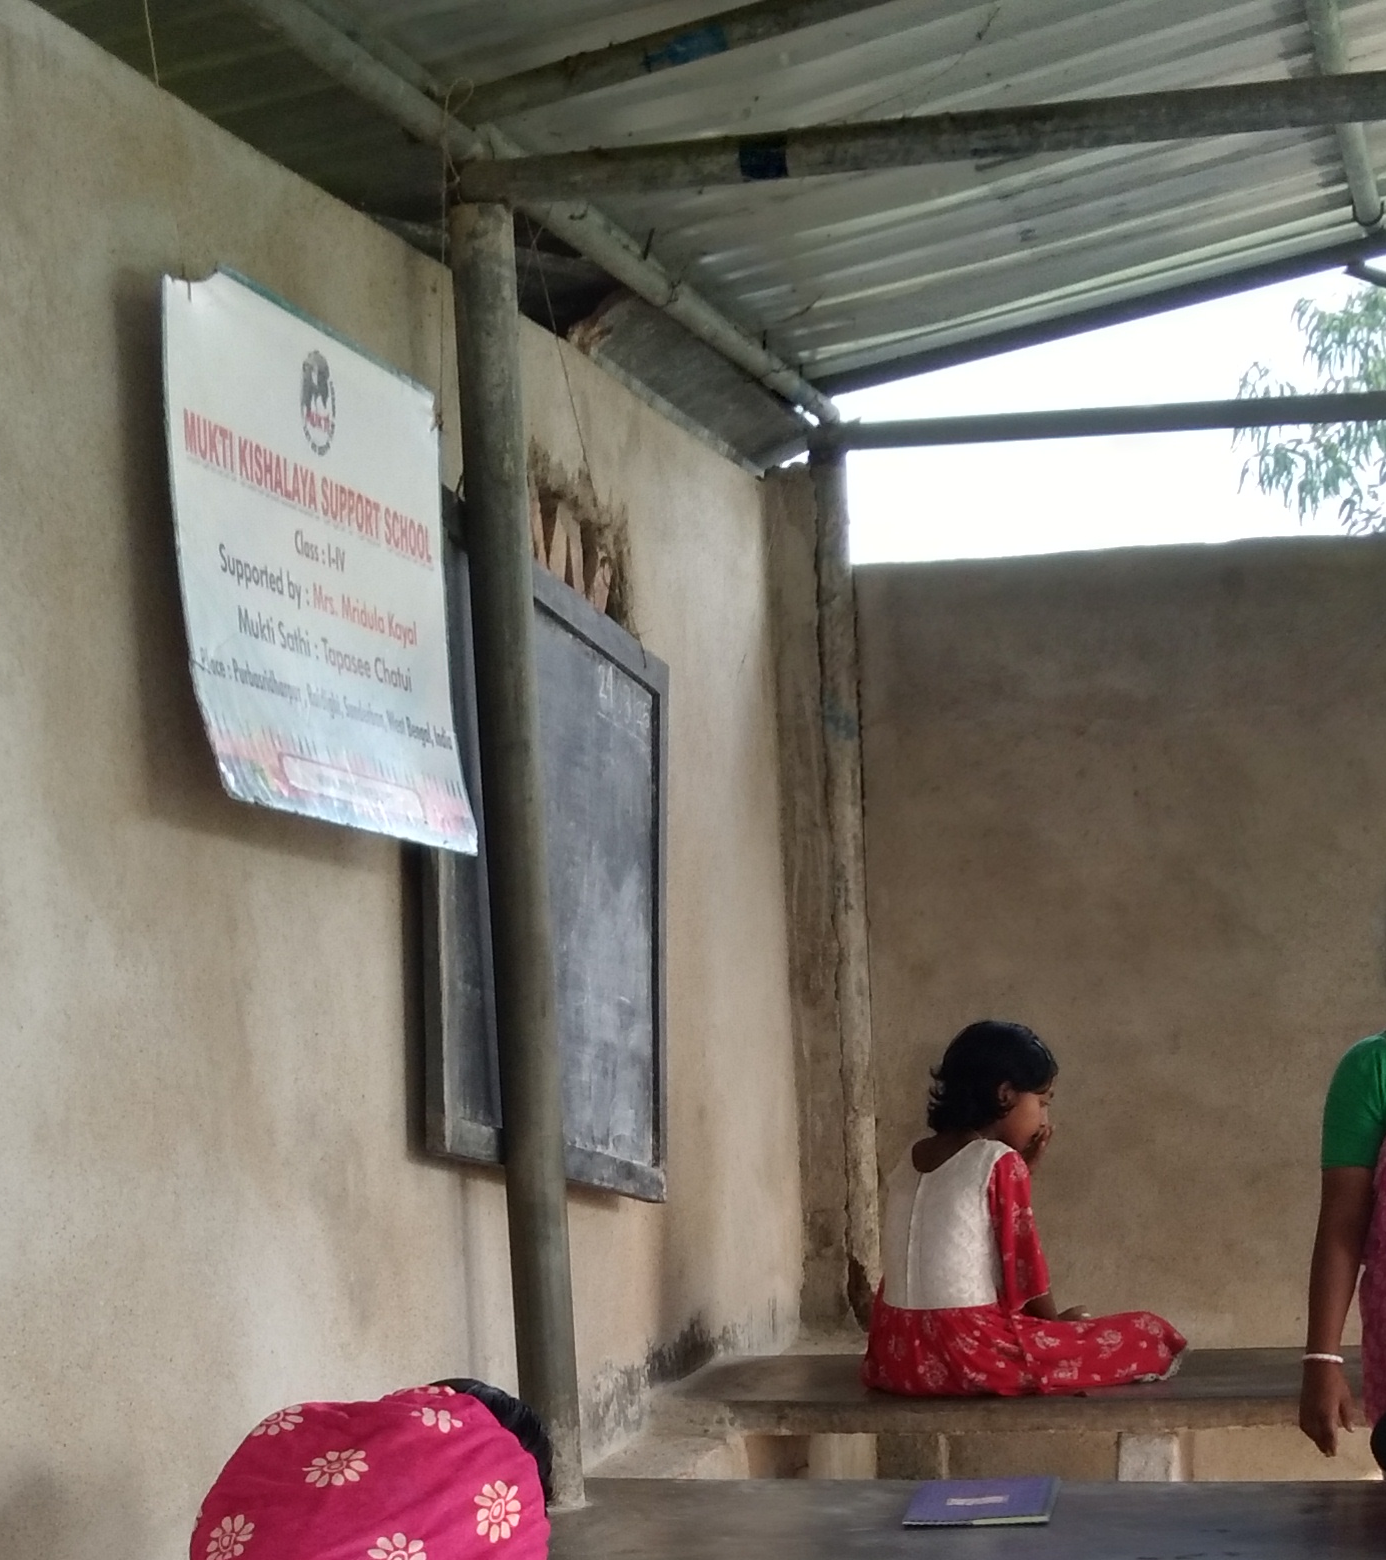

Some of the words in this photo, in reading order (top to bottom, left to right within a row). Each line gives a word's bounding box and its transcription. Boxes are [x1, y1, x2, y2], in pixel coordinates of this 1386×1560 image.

[183, 407, 234, 474] MUKTI
[238, 435, 318, 513] KISHALAYA
[321, 476, 381, 540] SUPPORT
[384, 507, 433, 563] SCHOOL
[294, 529, 319, 562] Class
[218, 542, 284, 596] Supported
[286, 569, 302, 610] by
[313, 582, 338, 617] Mrs.
[341, 593, 385, 634] Mridula
[387, 611, 418, 649] Kayal
[237, 604, 276, 645] Mukti
[277, 620, 312, 657] Sathi
[320, 637, 372, 679] Tapasee
[374, 656, 413, 693] Chatui
